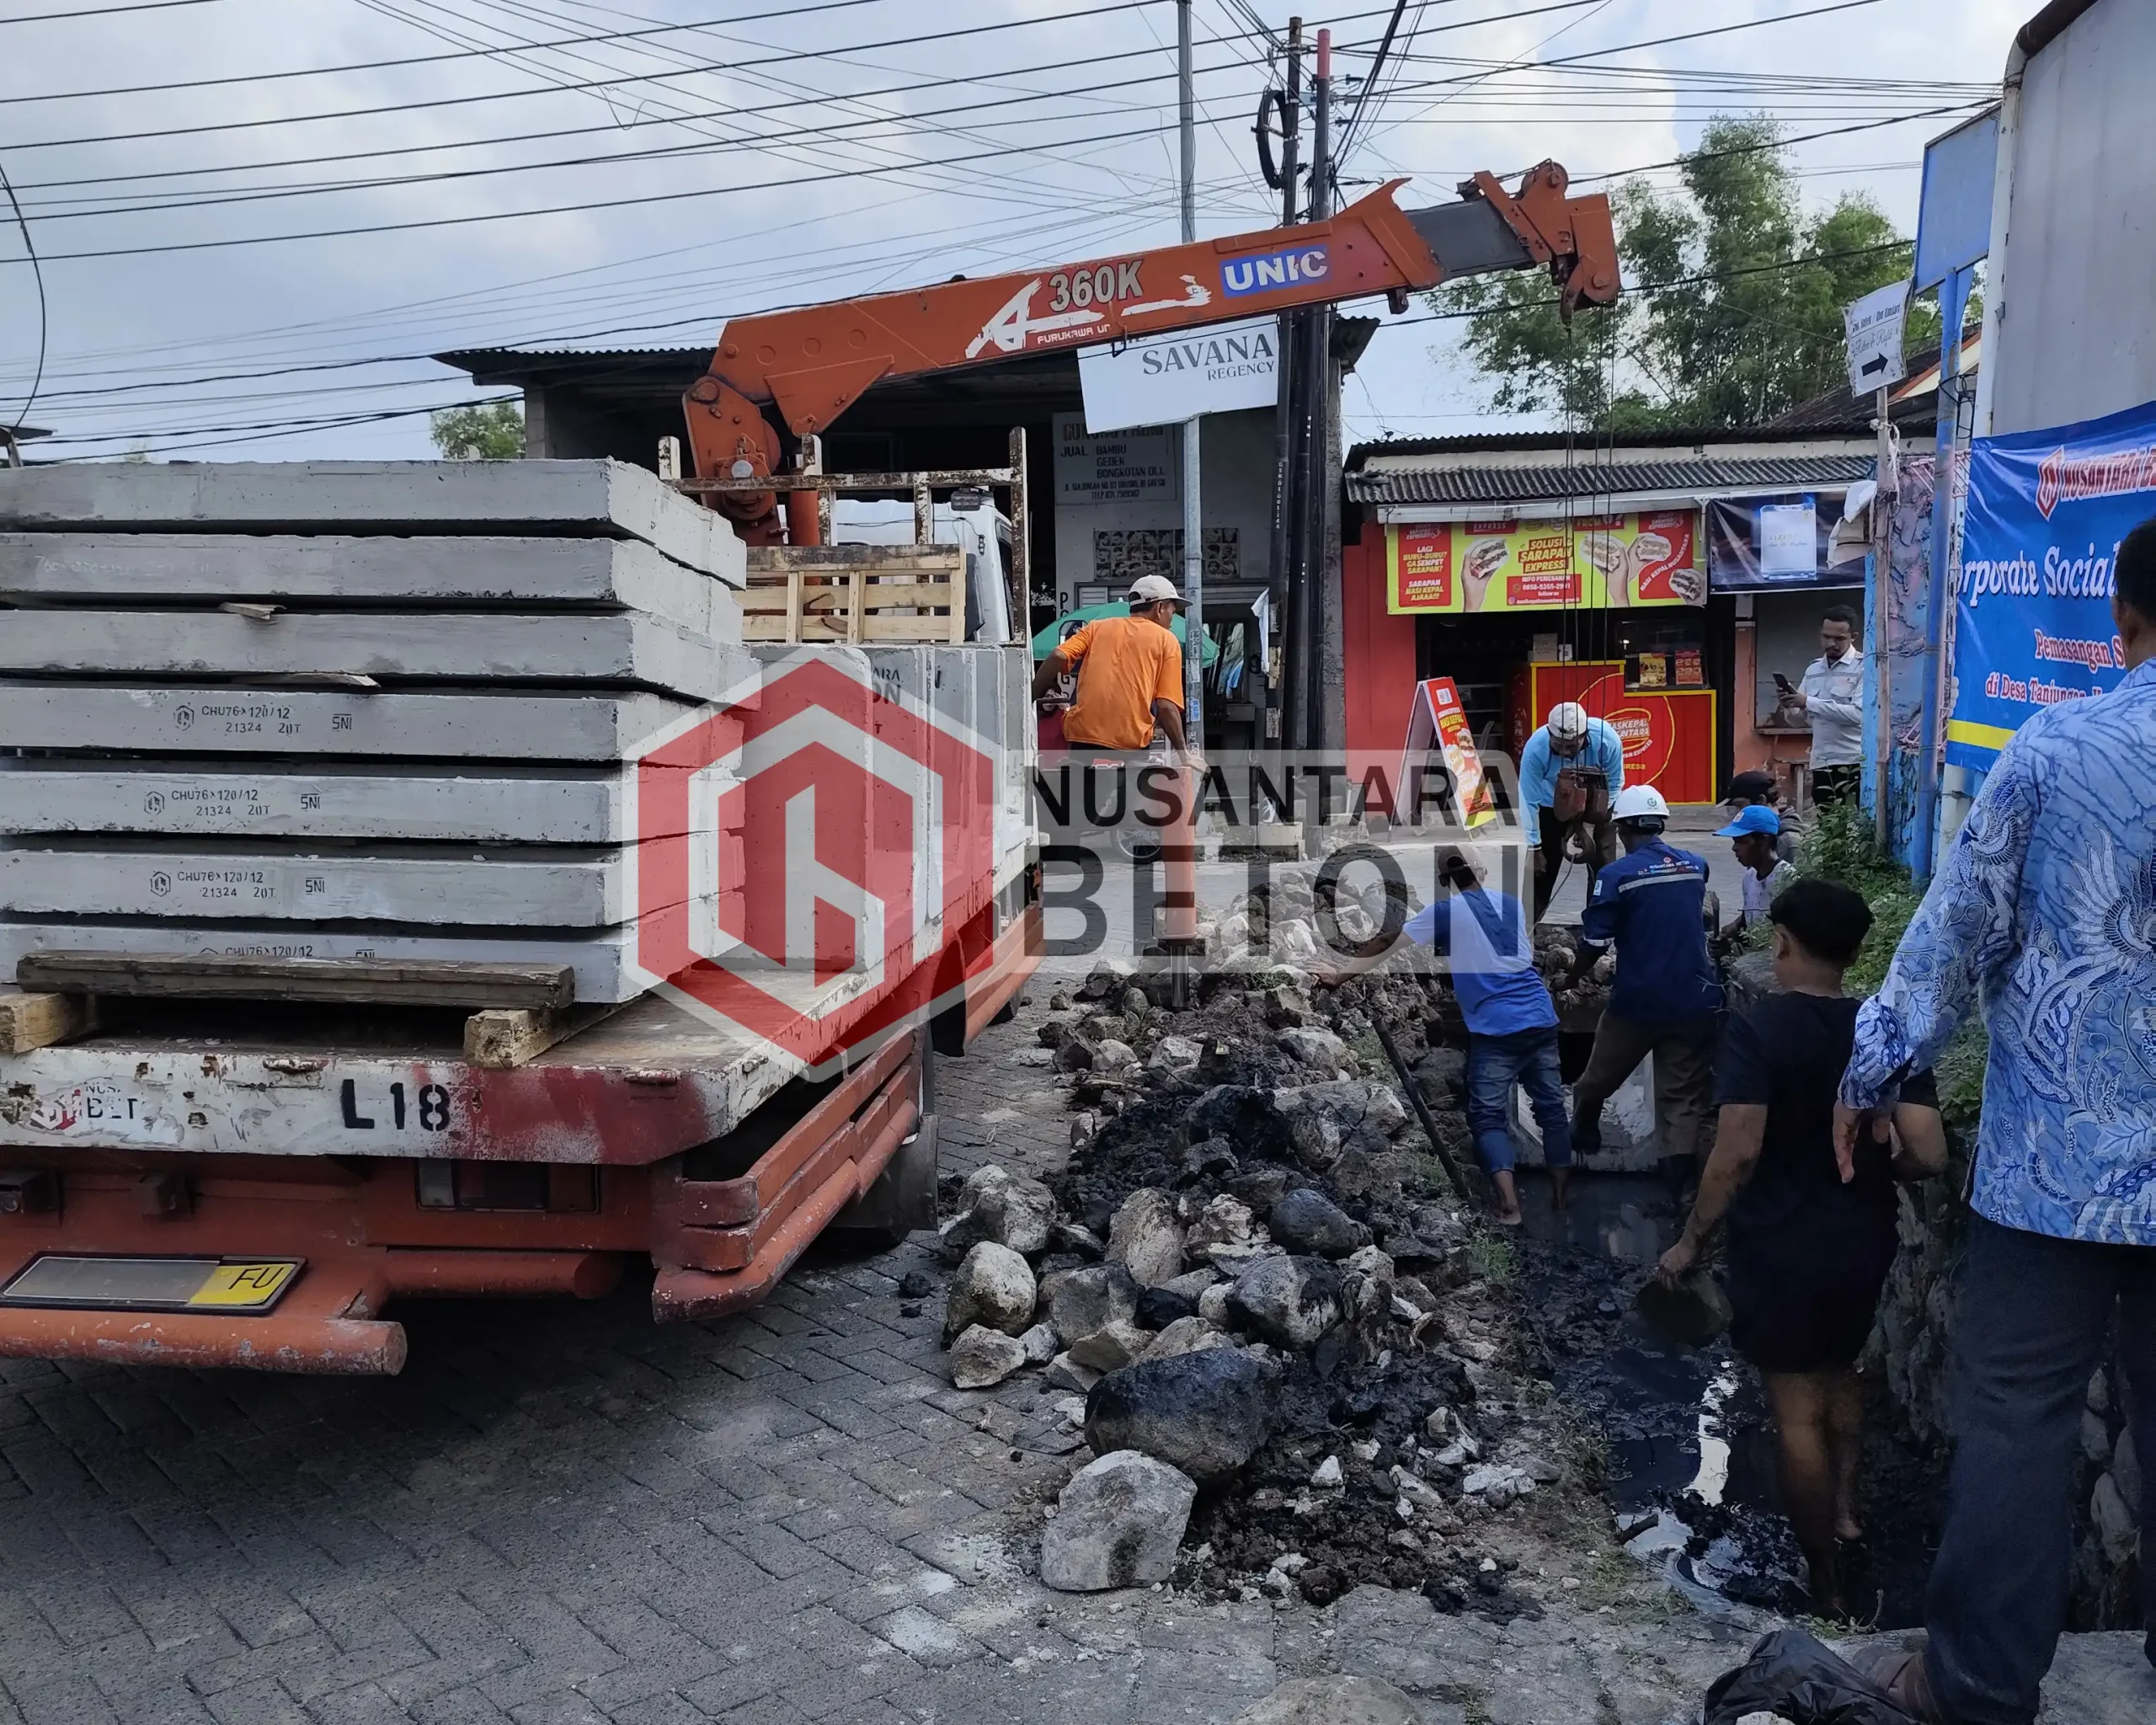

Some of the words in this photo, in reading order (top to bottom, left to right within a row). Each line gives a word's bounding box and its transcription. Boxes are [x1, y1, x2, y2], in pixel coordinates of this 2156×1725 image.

[1225, 251, 1328, 291] UNIC
[1048, 259, 1145, 312] 360K
[1037, 327, 1094, 344] FURUKAWA
[1142, 334, 1274, 375] SAVANA
[1208, 360, 1275, 381] REGENCY
[1060, 446, 1088, 457] JUAL
[1096, 444, 1127, 455] BAMBU
[1097, 457, 1125, 467] GEDEK
[1097, 467, 1146, 478] BONGKOTAN
[2062, 450, 2140, 498] NUSANTARA
[1530, 538, 1564, 549] SOLUSI
[1520, 547, 1573, 562] SARAPAN
[1407, 565, 1444, 574] SARAPAN?
[1957, 550, 2040, 606] rporate
[2043, 541, 2121, 597] Social
[1408, 579, 1441, 587] SARAPAN
[1422, 585, 1444, 594] KEPAL
[2034, 628, 2113, 674] Pemasangan
[1986, 672, 1999, 697] di
[2000, 673, 2027, 702] Desa
[226, 722, 262, 734] 21324
[278, 722, 302, 734] 20T
[332, 713, 352, 730] SNI
[195, 805, 232, 816] 21324
[248, 804, 270, 815] 20T
[300, 793, 321, 810] SNI
[201, 887, 237, 898] 21324
[253, 887, 276, 899] 20T
[305, 877, 325, 895] SNI
[339, 1079, 451, 1131] L18
[228, 1266, 283, 1290] FU
